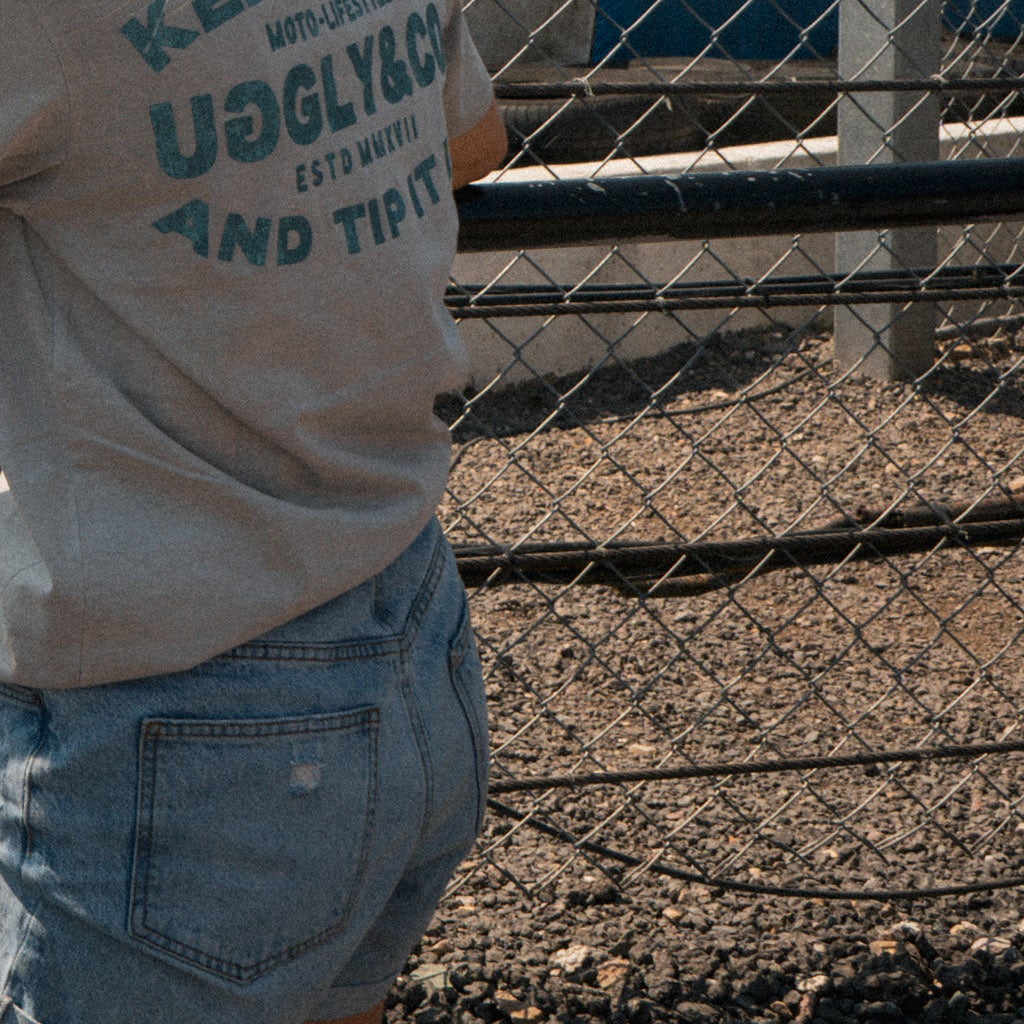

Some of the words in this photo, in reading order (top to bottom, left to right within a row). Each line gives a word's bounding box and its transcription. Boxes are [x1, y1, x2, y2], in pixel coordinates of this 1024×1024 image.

[296, 148, 353, 193] ESTD
[357, 114, 418, 167] MMXVII
[151, 199, 313, 266] AND
[332, 188, 406, 254] TIP
[407, 154, 441, 218] IT
